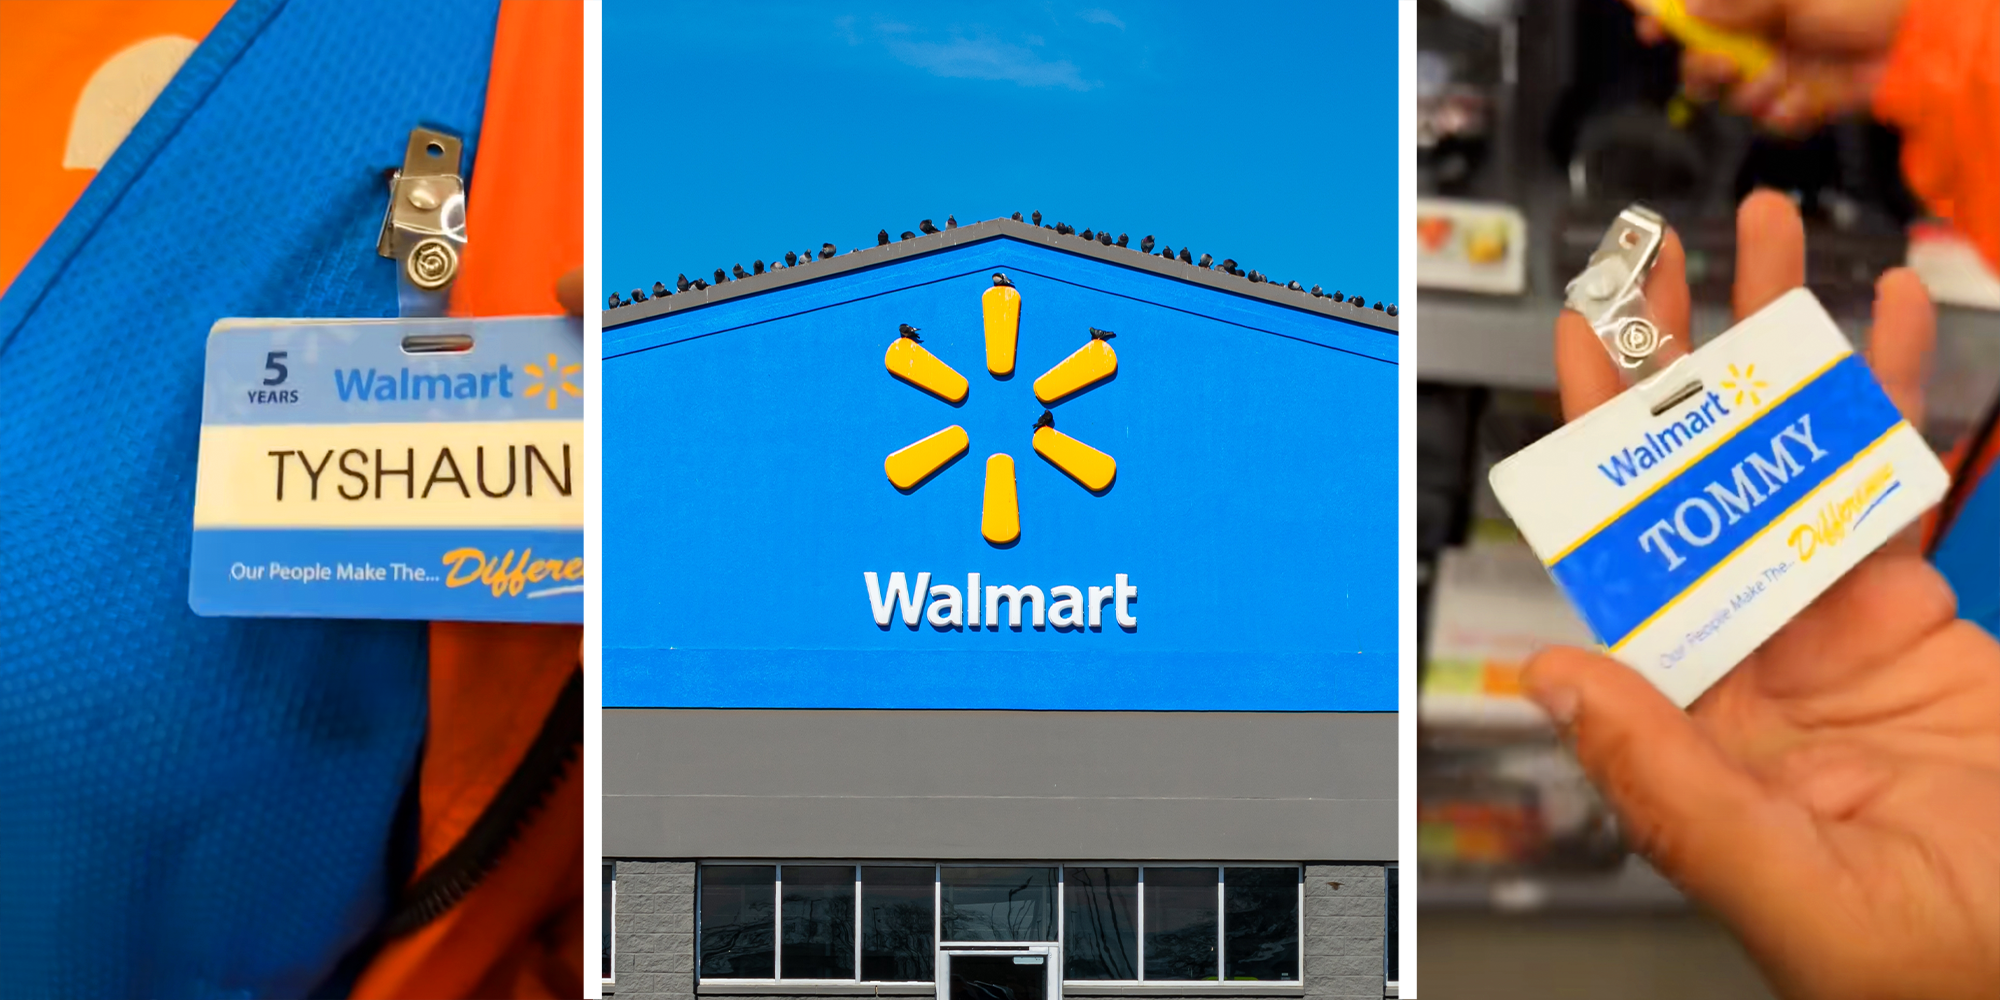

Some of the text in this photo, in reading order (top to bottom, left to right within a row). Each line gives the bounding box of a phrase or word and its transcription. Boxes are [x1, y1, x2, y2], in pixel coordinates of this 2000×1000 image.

[263, 351, 289, 387] 5
[334, 364, 514, 403] Walmart
[248, 390, 299, 405] YEARS
[1597, 390, 1730, 488] Walmart
[268, 443, 573, 501] TYSHAUN
[1638, 413, 1829, 573] TOMMY
[231, 561, 265, 581] Our
[269, 561, 332, 584] People
[336, 561, 387, 581] Make
[389, 562, 440, 582] The...
[863, 571, 1138, 627] Walmart
[1730, 581, 1767, 612] Make
